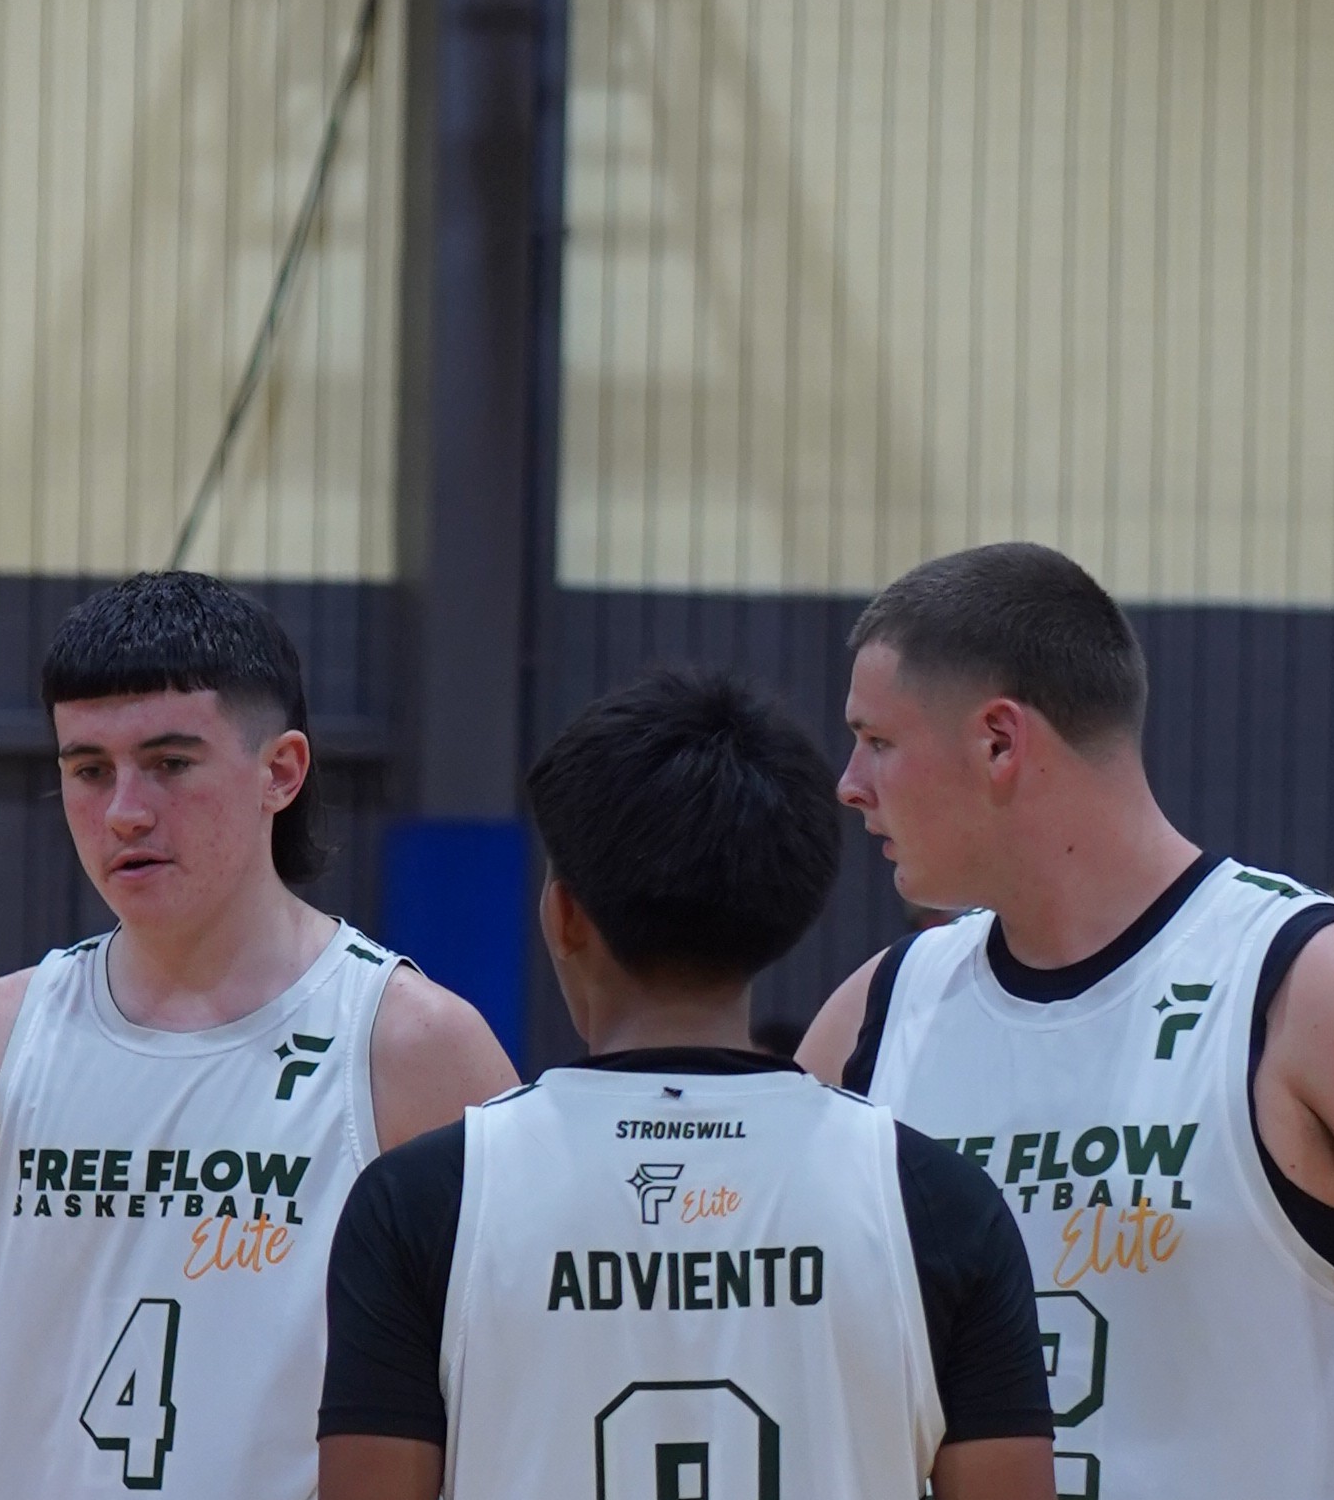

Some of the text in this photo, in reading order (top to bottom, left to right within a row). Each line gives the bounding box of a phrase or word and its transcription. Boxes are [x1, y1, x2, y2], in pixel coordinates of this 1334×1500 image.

[615, 1120, 747, 1140] STRONGWILL
[1004, 1122, 1200, 1185] FLOW
[17, 1148, 312, 1198] FREE FLOW
[999, 1178, 1193, 1214] TBALL
[680, 1186, 743, 1224] Elite
[183, 1212, 297, 1281] Elite
[1053, 1196, 1185, 1288] Elite
[547, 1246, 824, 1311] ADVIENTO
[80, 1298, 181, 1490] 4
